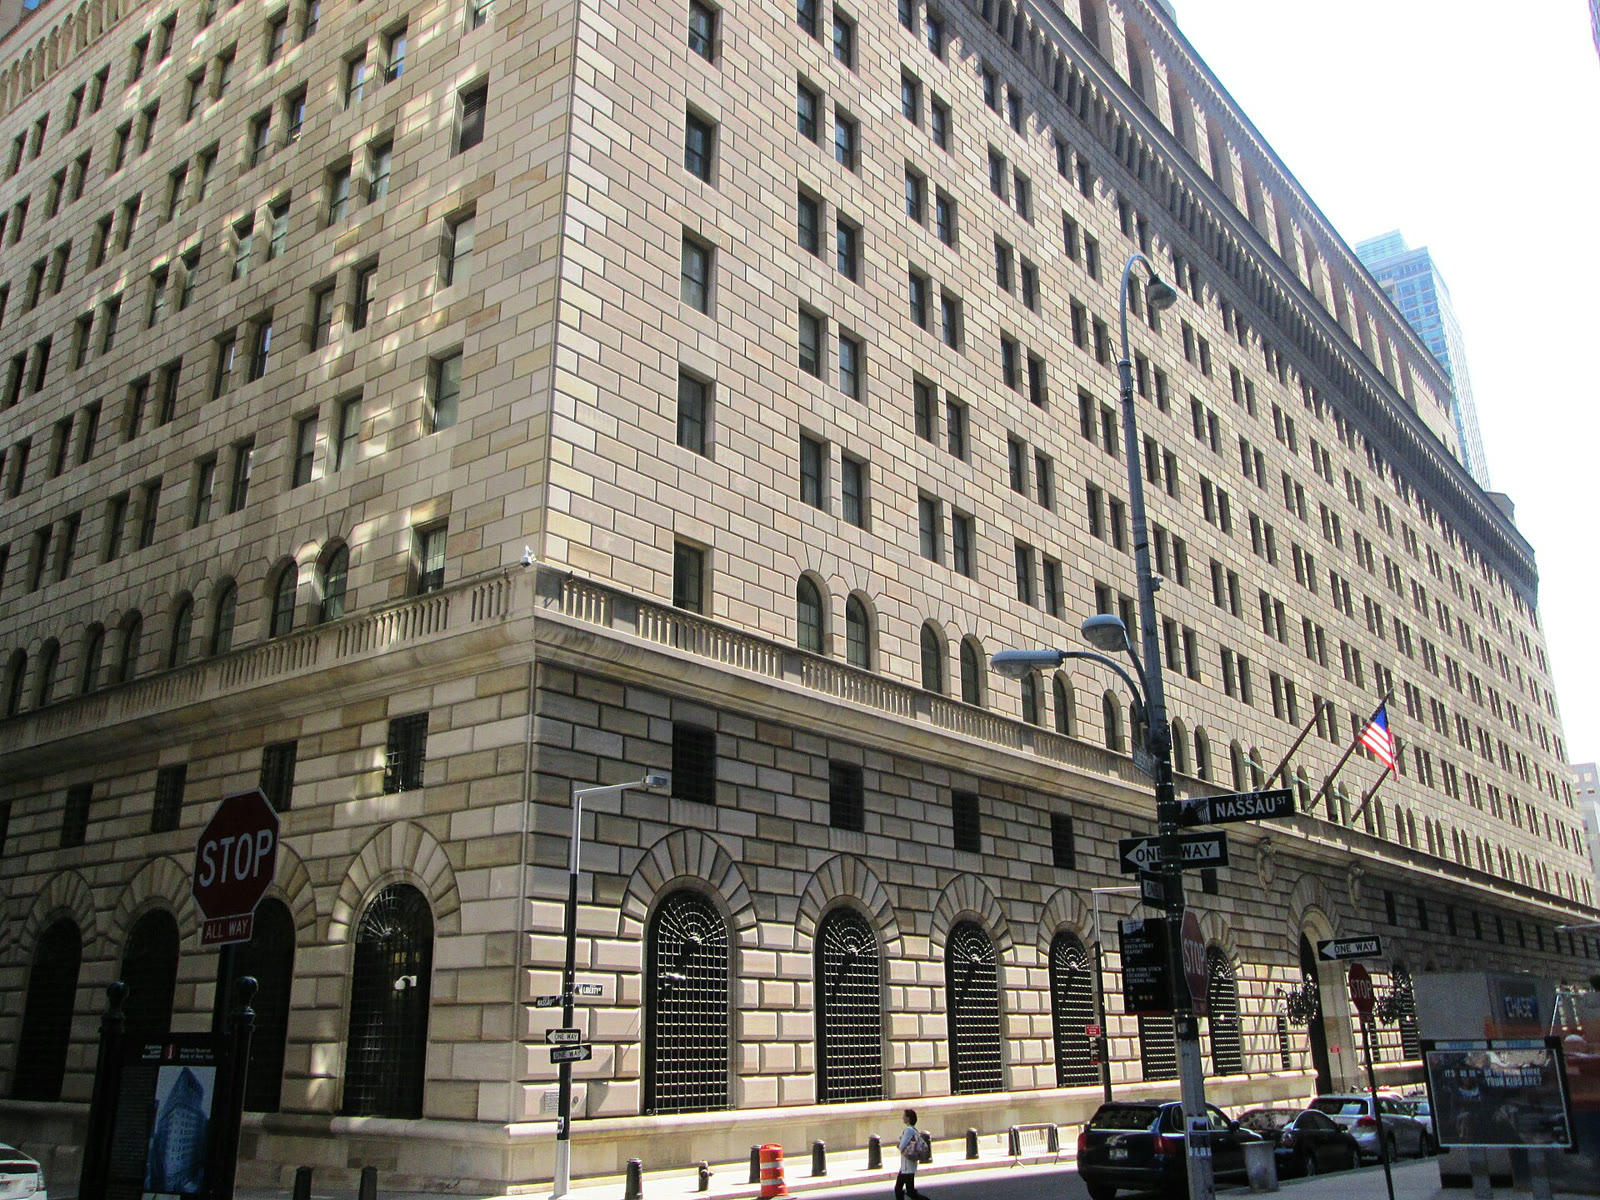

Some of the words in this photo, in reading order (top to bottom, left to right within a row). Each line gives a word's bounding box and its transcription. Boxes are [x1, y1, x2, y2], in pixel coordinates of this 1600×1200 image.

[1215, 798, 1276, 818] NASSAU
[1276, 796, 1286, 805] ST
[199, 829, 273, 888] STOP
[1180, 843, 1212, 858] WAY
[205, 925, 223, 940] ALL
[229, 919, 249, 936] WAY
[1184, 938, 1206, 977] STOP
[1334, 944, 1352, 954] ONE
[1355, 941, 1374, 952] WAY
[1350, 979, 1372, 999] STOP
[1504, 996, 1533, 1018] CHASE
[566, 1032, 578, 1040] WAY
[569, 1049, 582, 1058] WAY
[1485, 1077, 1505, 1087] YOUR
